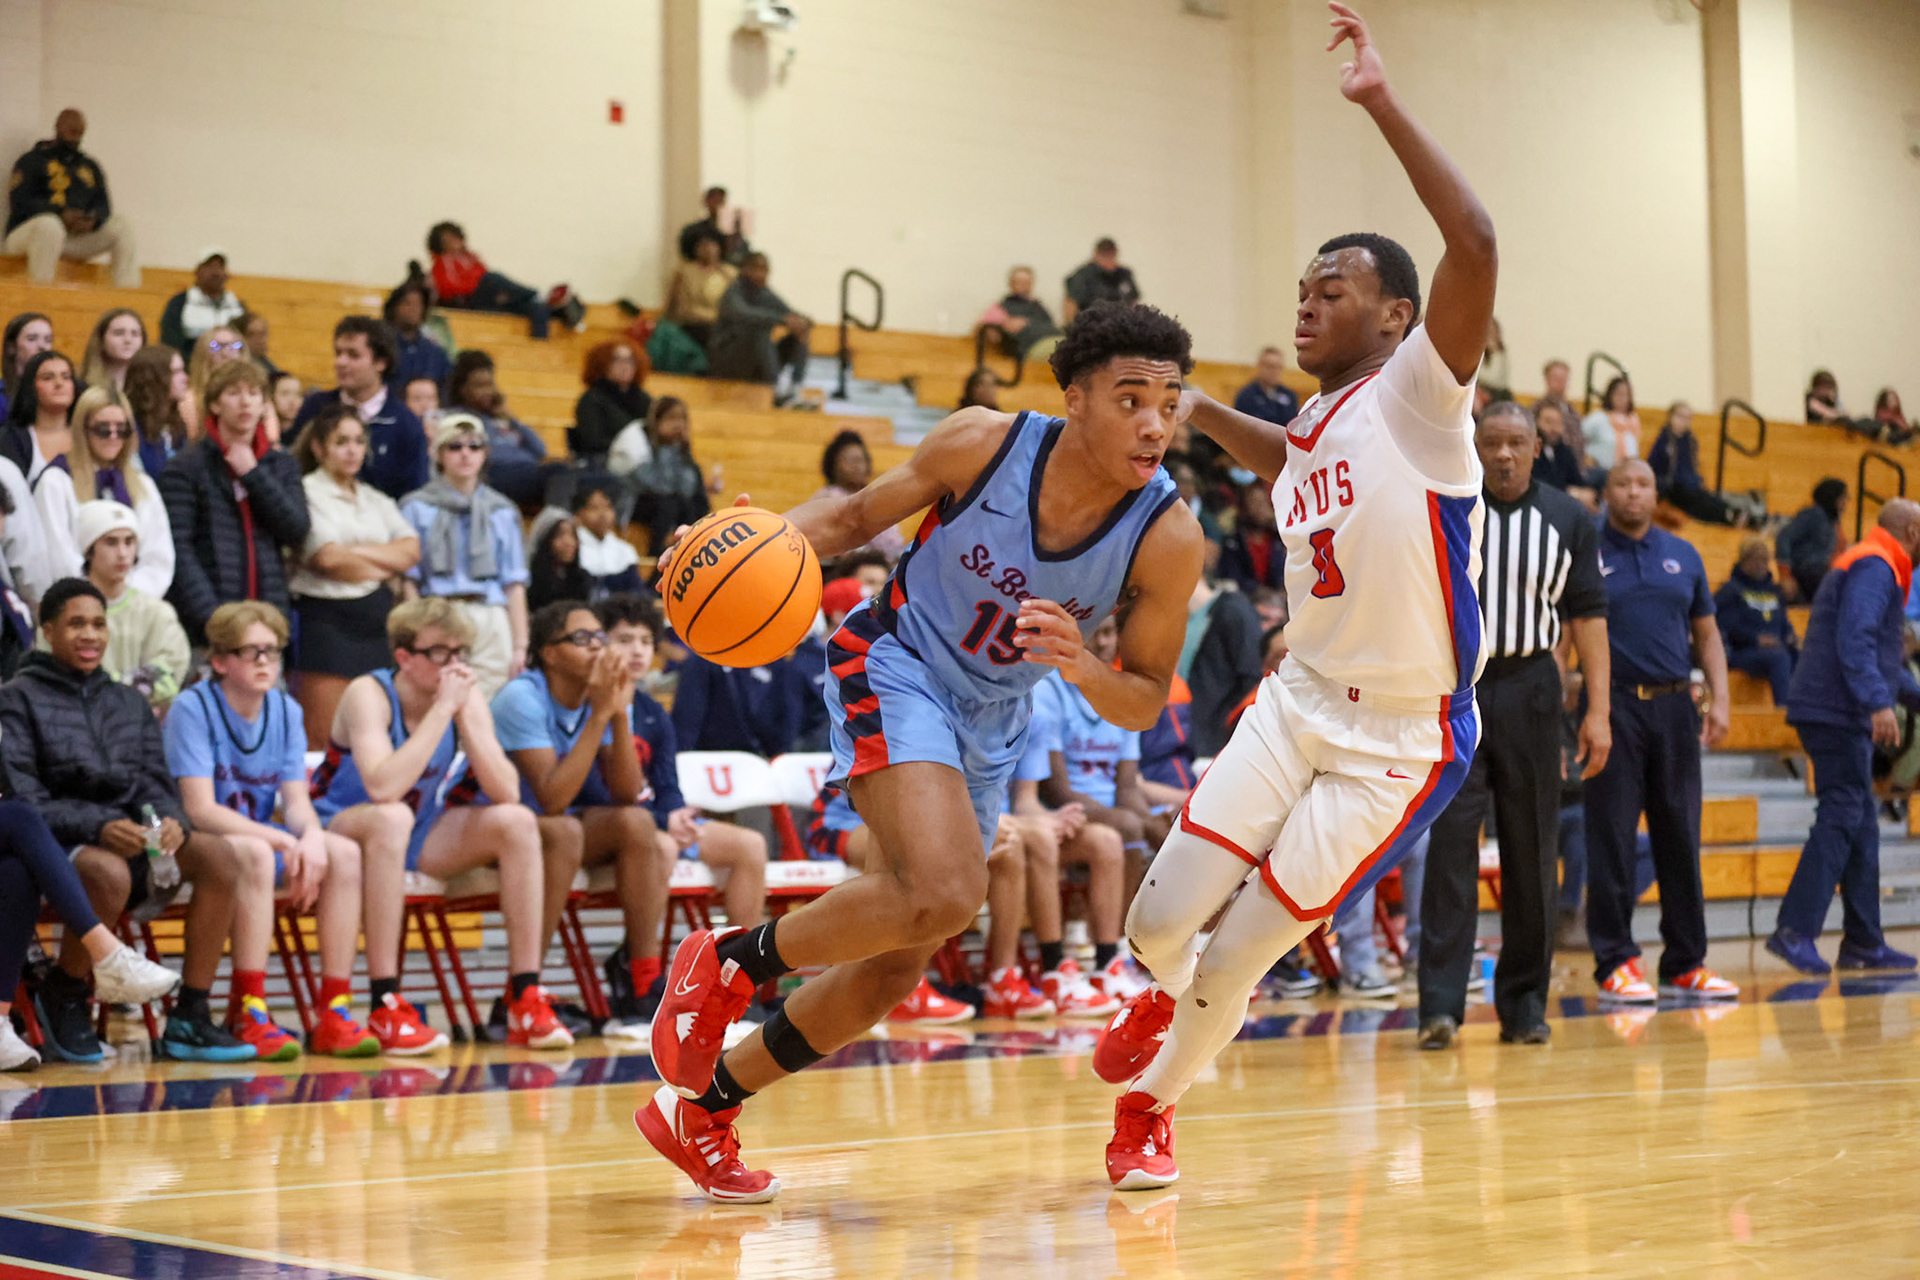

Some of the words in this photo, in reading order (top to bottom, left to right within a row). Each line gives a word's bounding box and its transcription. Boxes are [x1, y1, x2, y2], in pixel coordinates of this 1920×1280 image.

[672, 520, 758, 602] Wilson
[959, 544, 995, 578] St
[959, 600, 1042, 666] 15
[1347, 686, 1361, 703] U
[705, 765, 733, 796] U
